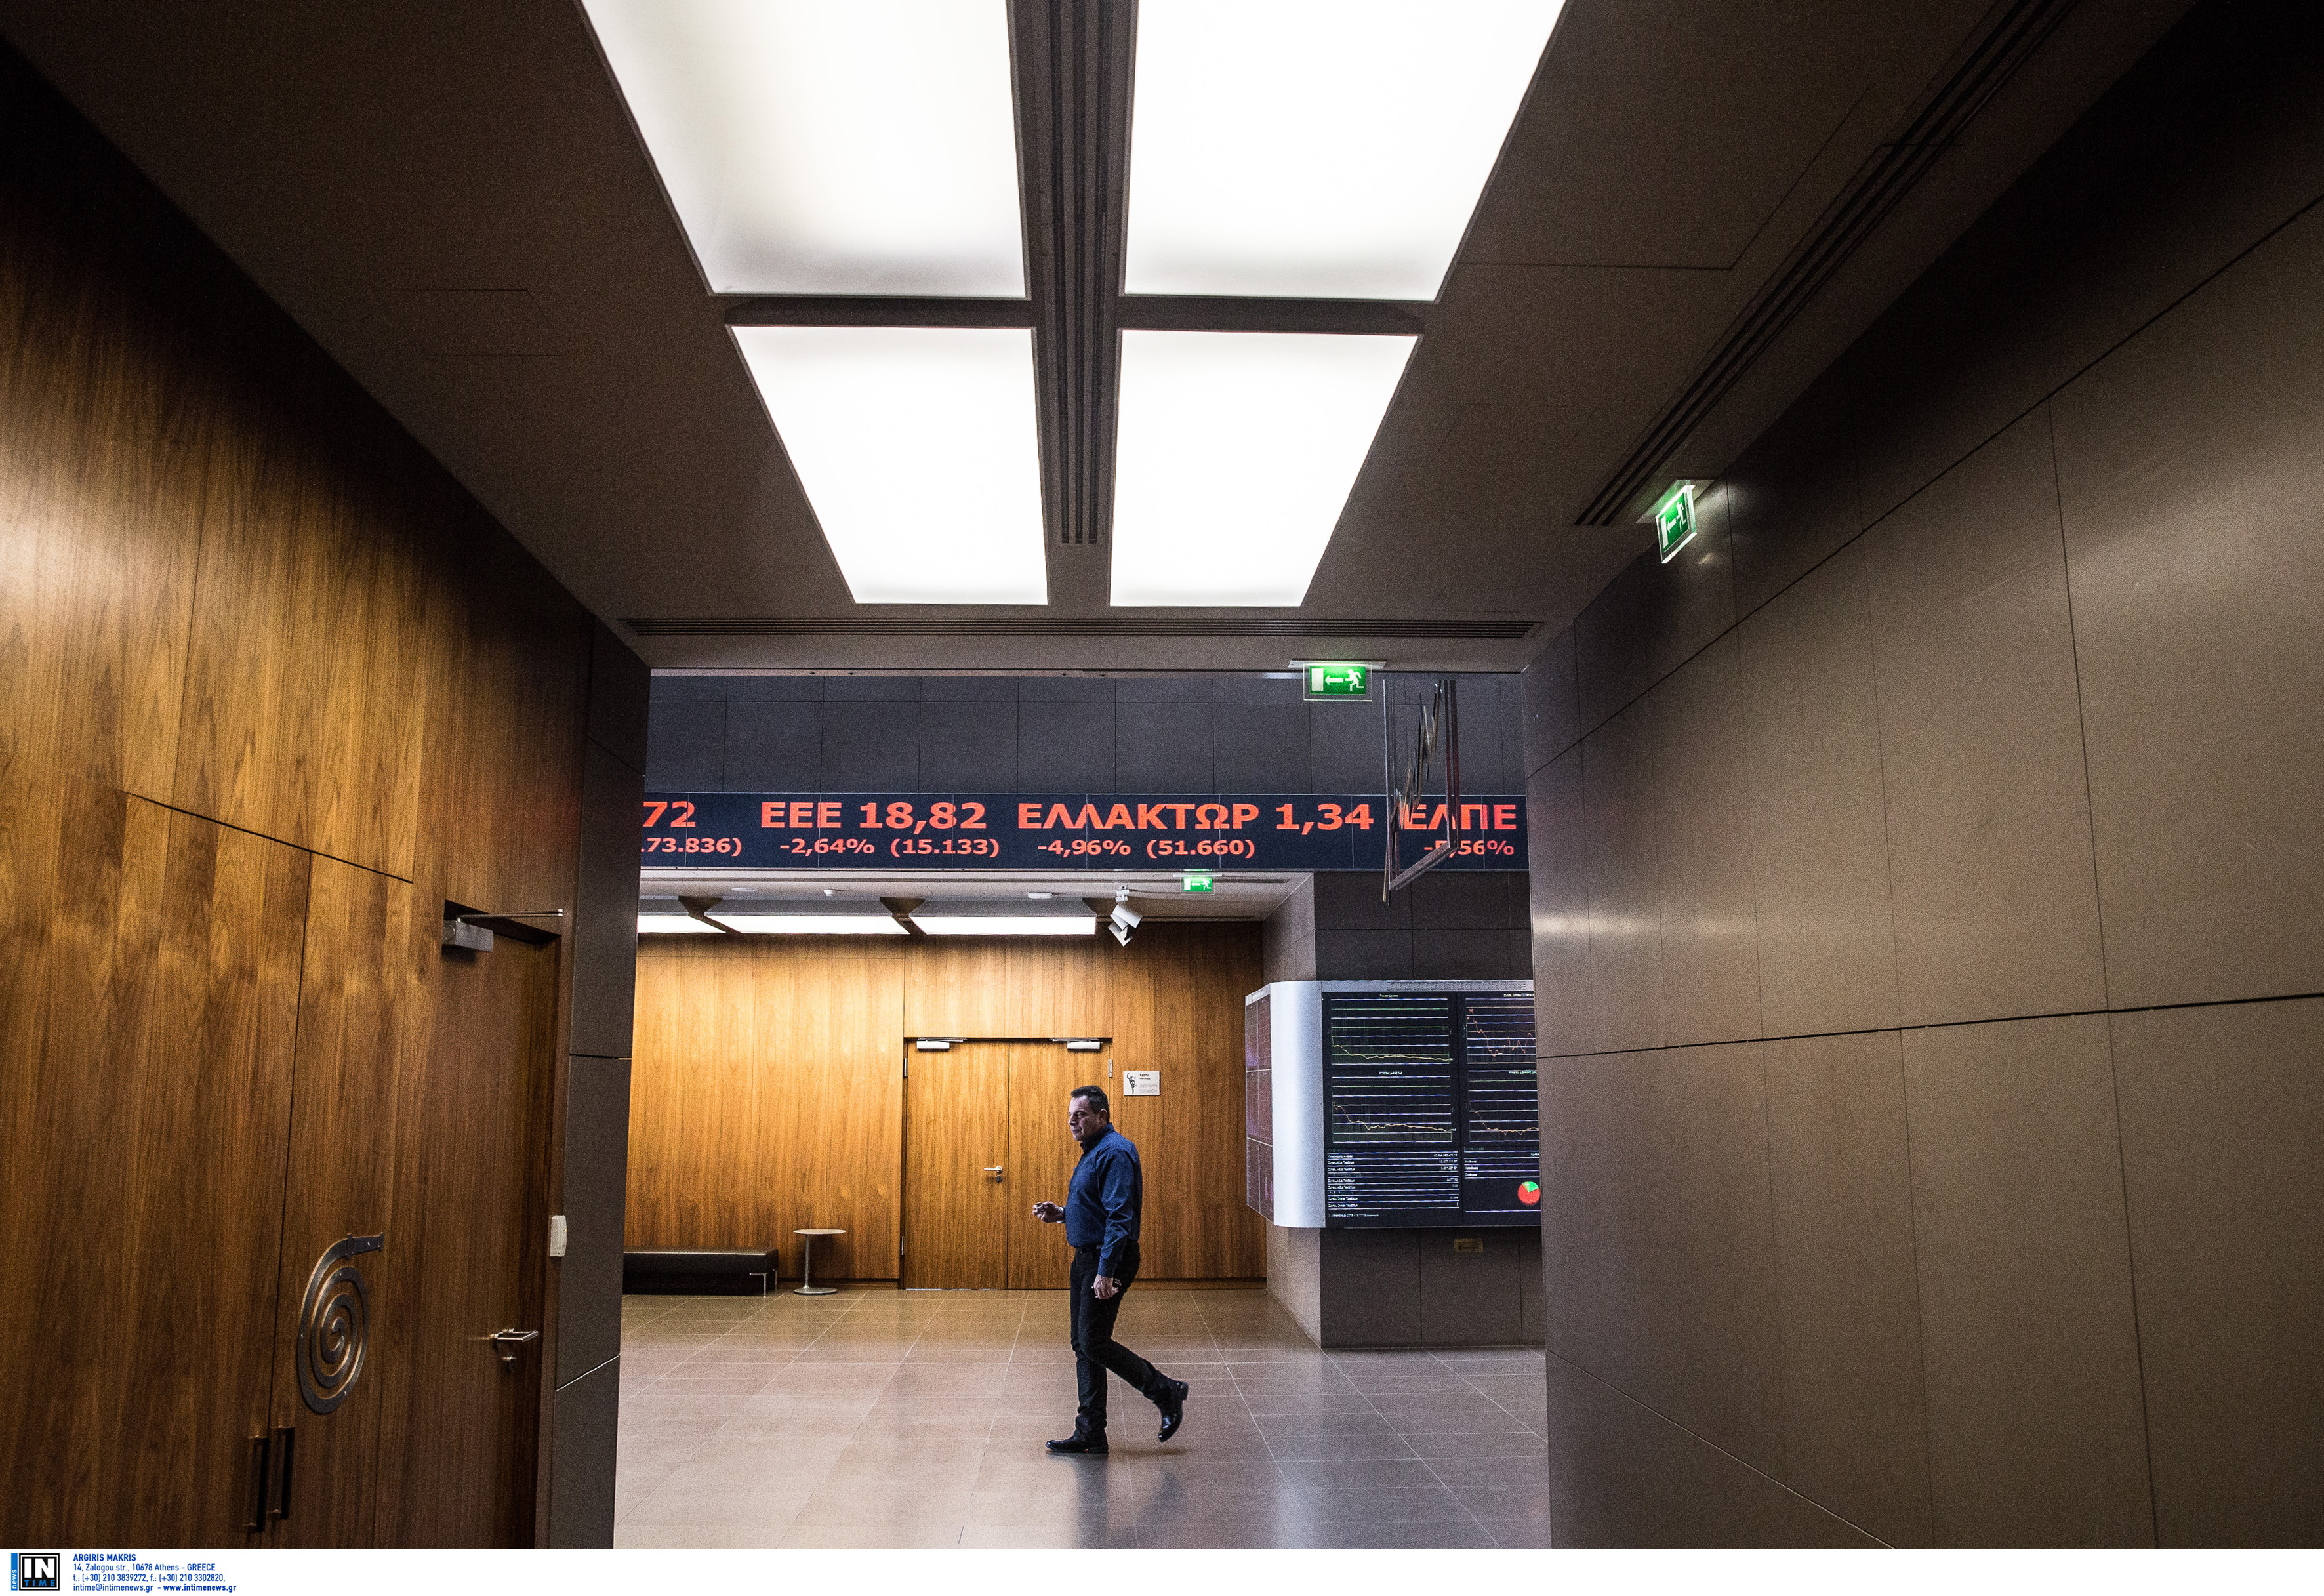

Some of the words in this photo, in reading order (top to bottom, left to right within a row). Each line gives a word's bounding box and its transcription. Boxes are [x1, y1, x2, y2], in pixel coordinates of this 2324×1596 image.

[642, 800, 696, 827] 72
[761, 802, 842, 829] ΕΕΕ
[859, 802, 987, 835] 18,82
[1018, 802, 1259, 829] ΕΛΛΑΚΤΩΡ
[1276, 803, 1374, 836] 1,34
[1399, 804, 1517, 830] ΕΛΠΕ
[780, 838, 875, 855] -2,64%
[890, 838, 1000, 857] (15.133)
[1038, 839, 1131, 858] -4,96%
[1147, 839, 1255, 859] (51.660)
